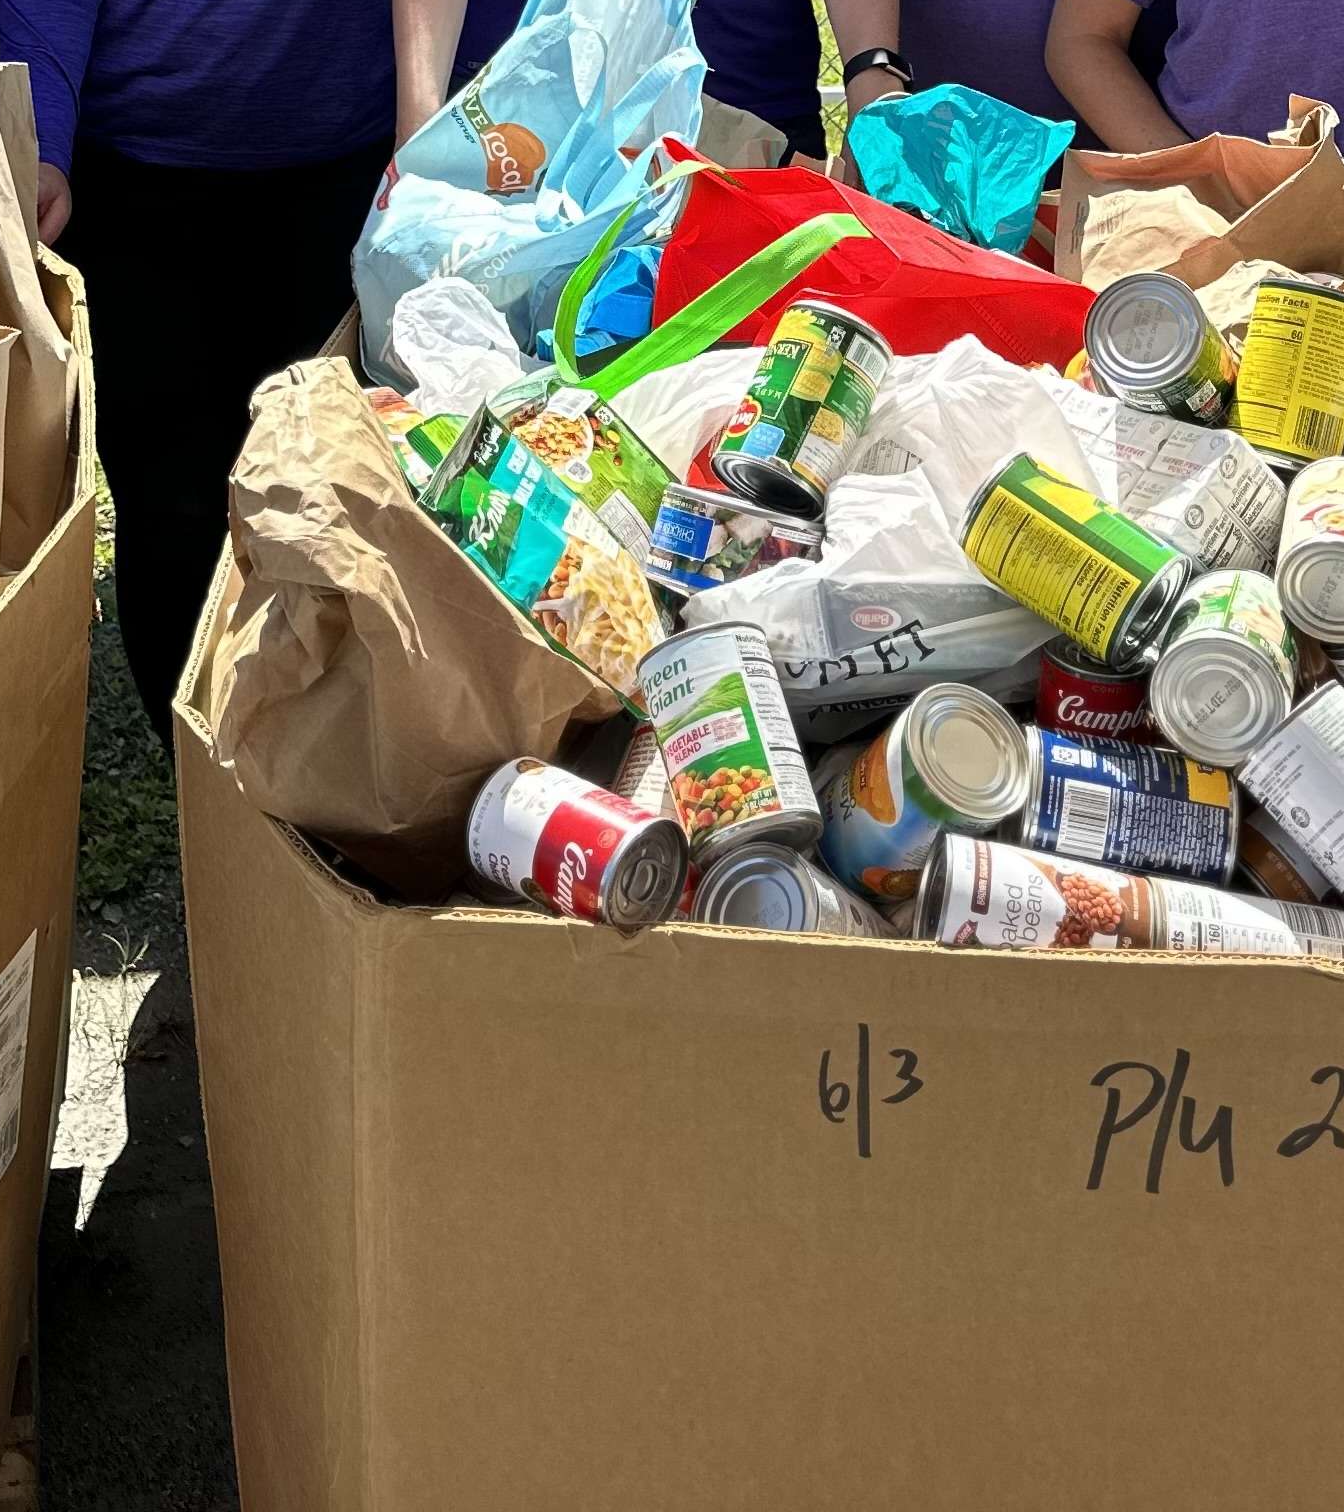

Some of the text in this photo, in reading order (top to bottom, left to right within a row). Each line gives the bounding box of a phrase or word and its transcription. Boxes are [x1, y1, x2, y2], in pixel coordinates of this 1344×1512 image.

[1282, 296, 1312, 310] Facts
[1076, 557, 1099, 588] Calories
[851, 611, 891, 627] Barilla
[1092, 578, 1131, 646] Nutrition Facts
[1016, 874, 1044, 943] beans
